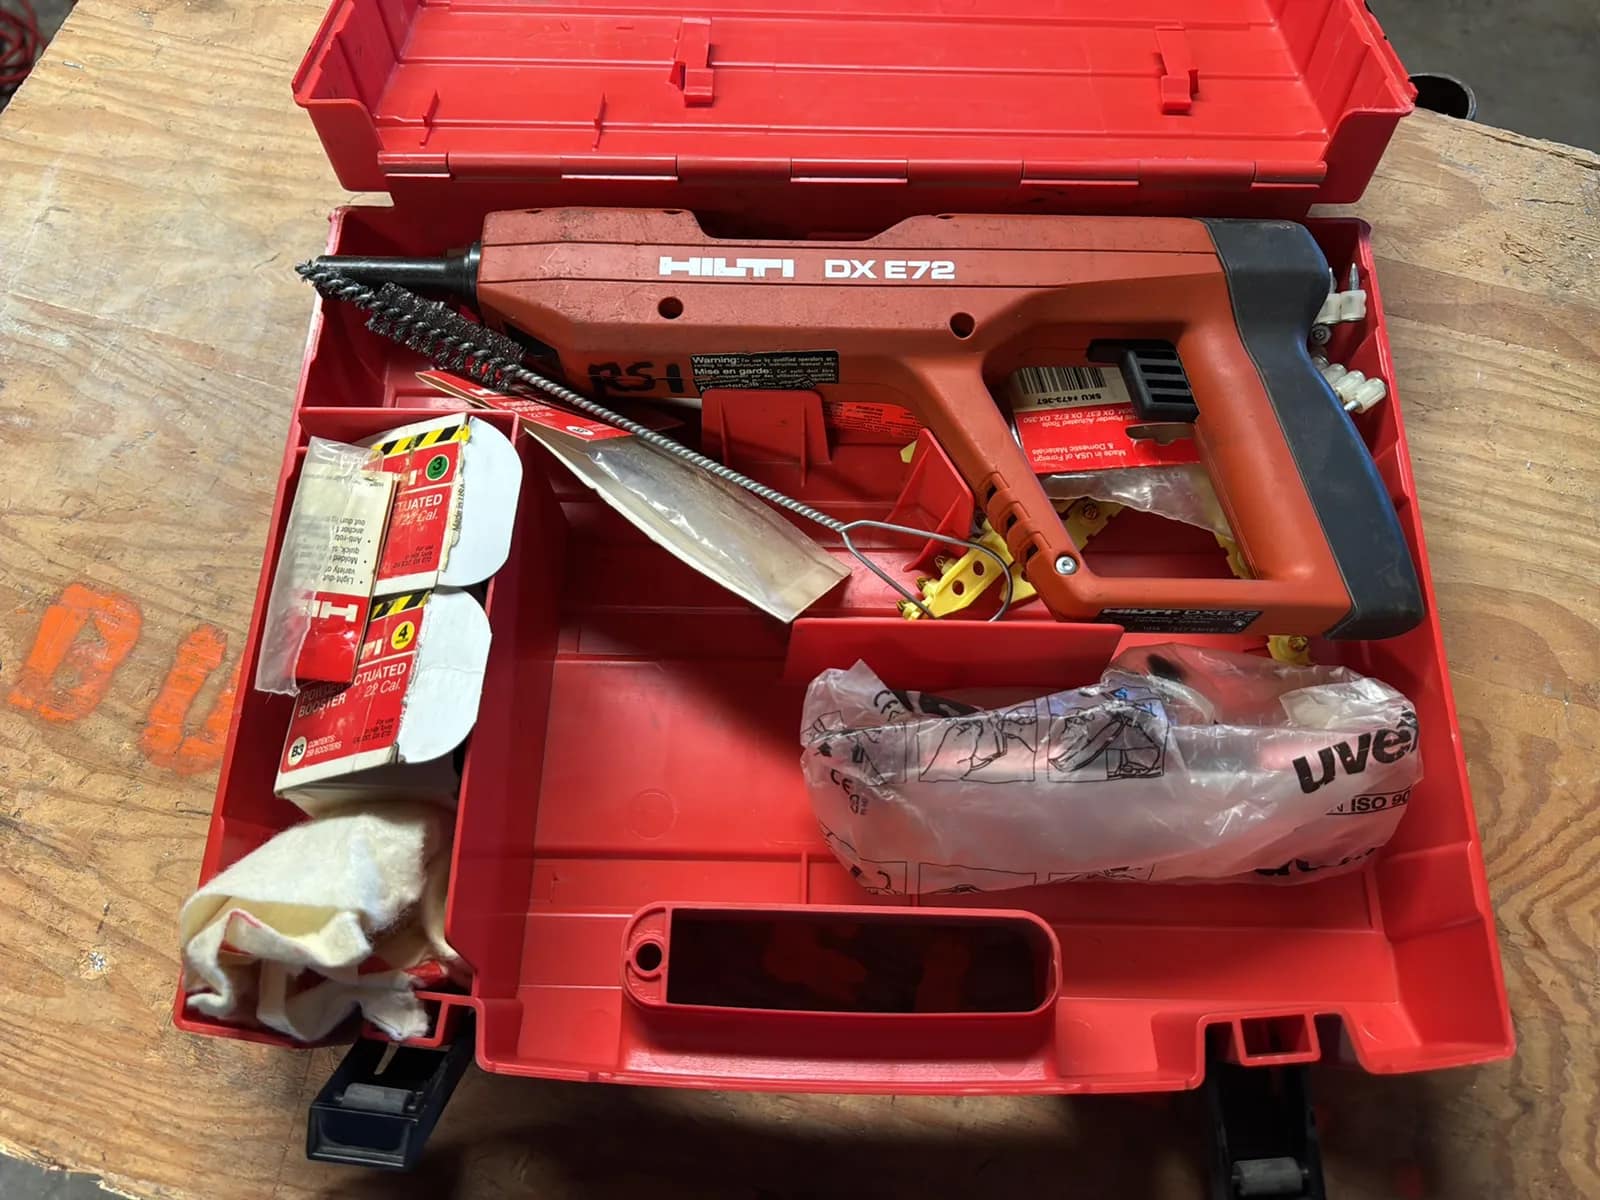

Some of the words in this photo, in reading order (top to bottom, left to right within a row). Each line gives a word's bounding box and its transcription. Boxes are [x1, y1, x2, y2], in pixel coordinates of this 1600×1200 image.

[659, 256, 794, 278] HILTI
[825, 259, 877, 279] DX
[885, 260, 956, 280] E72
[692, 356, 740, 365] Warning:
[739, 368, 773, 376] garde:
[1081, 393, 1102, 401] SKU
[1062, 418, 1095, 426] Actuated
[1096, 414, 1124, 422] Powder
[1031, 446, 1069, 455] Materials
[1069, 443, 1106, 451] Domestic
[1075, 451, 1094, 460] USA
[1103, 449, 1127, 457] Made
[1033, 454, 1064, 462] Foreign
[431, 458, 442, 471] 3
[398, 494, 443, 512] TUATED
[332, 554, 359, 565] Molded
[332, 565, 356, 575] variety
[398, 624, 408, 640] 4
[353, 662, 407, 687] CTUATED
[298, 692, 347, 718] BOOSTER
[291, 743, 305, 759] B3
[1351, 796, 1387, 812] ISO
